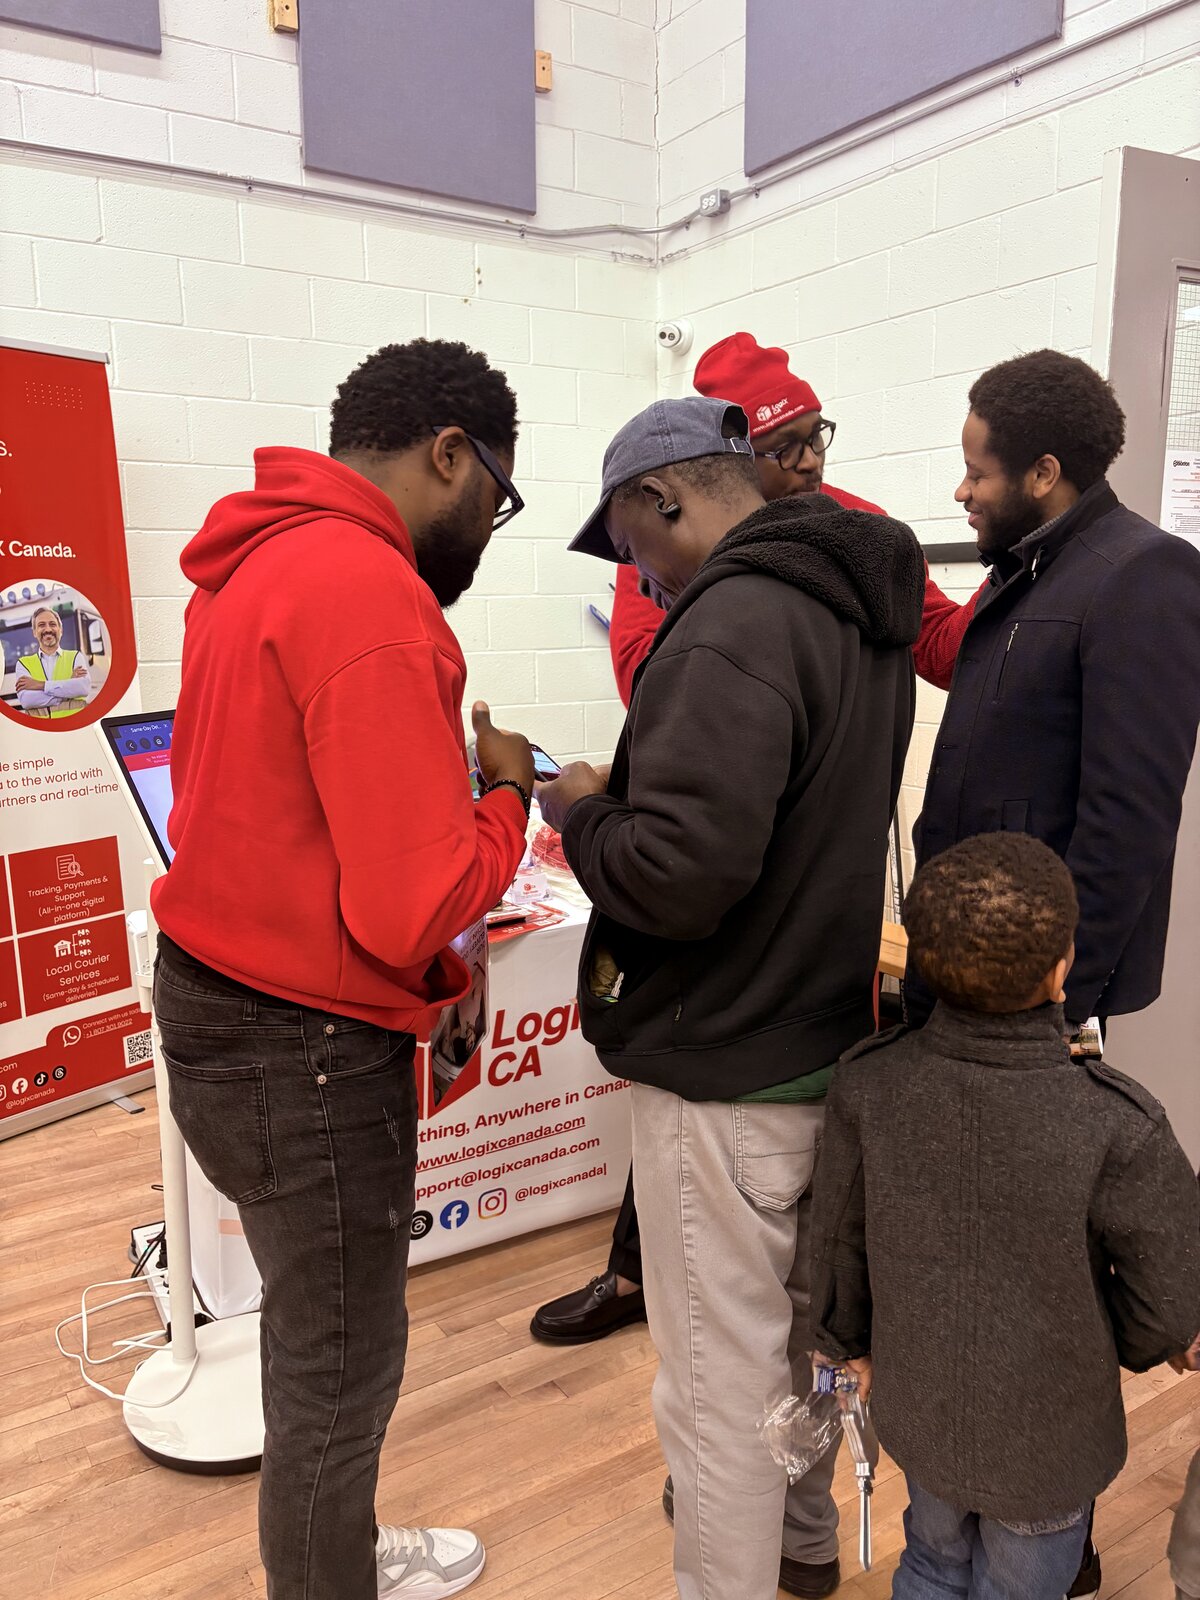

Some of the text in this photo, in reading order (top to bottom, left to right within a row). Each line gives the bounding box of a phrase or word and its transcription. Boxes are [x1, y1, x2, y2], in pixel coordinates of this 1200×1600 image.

[9, 540, 76, 558] Canada.
[13, 757, 54, 771] simple
[6, 779, 19, 789] to
[21, 776, 42, 787] the
[45, 770, 78, 784] world
[80, 767, 103, 779] with
[40, 789, 64, 802] and
[67, 783, 119, 798] real-time
[28, 885, 63, 898] Tracking,
[64, 877, 102, 891] Payments
[54, 890, 86, 902] Support
[38, 896, 105, 917] (All-in-one digital
[53, 908, 90, 924] platform)
[46, 954, 110, 977] Local Courier
[42, 986, 80, 1002] (Same-day
[87, 975, 120, 989] scheduled
[59, 969, 101, 987] Services
[65, 988, 98, 1003] deliveries)
[82, 1018, 107, 1030] Connect
[108, 1014, 121, 1022] with
[487, 1045, 542, 1087] CA
[5, 1087, 56, 1110] @logixcanada
[475, 1097, 561, 1130] Anywhere
[565, 1091, 579, 1105] in
[416, 1115, 586, 1173] www.logixcanada.com
[416, 1137, 600, 1201] pport@logixcanada.com
